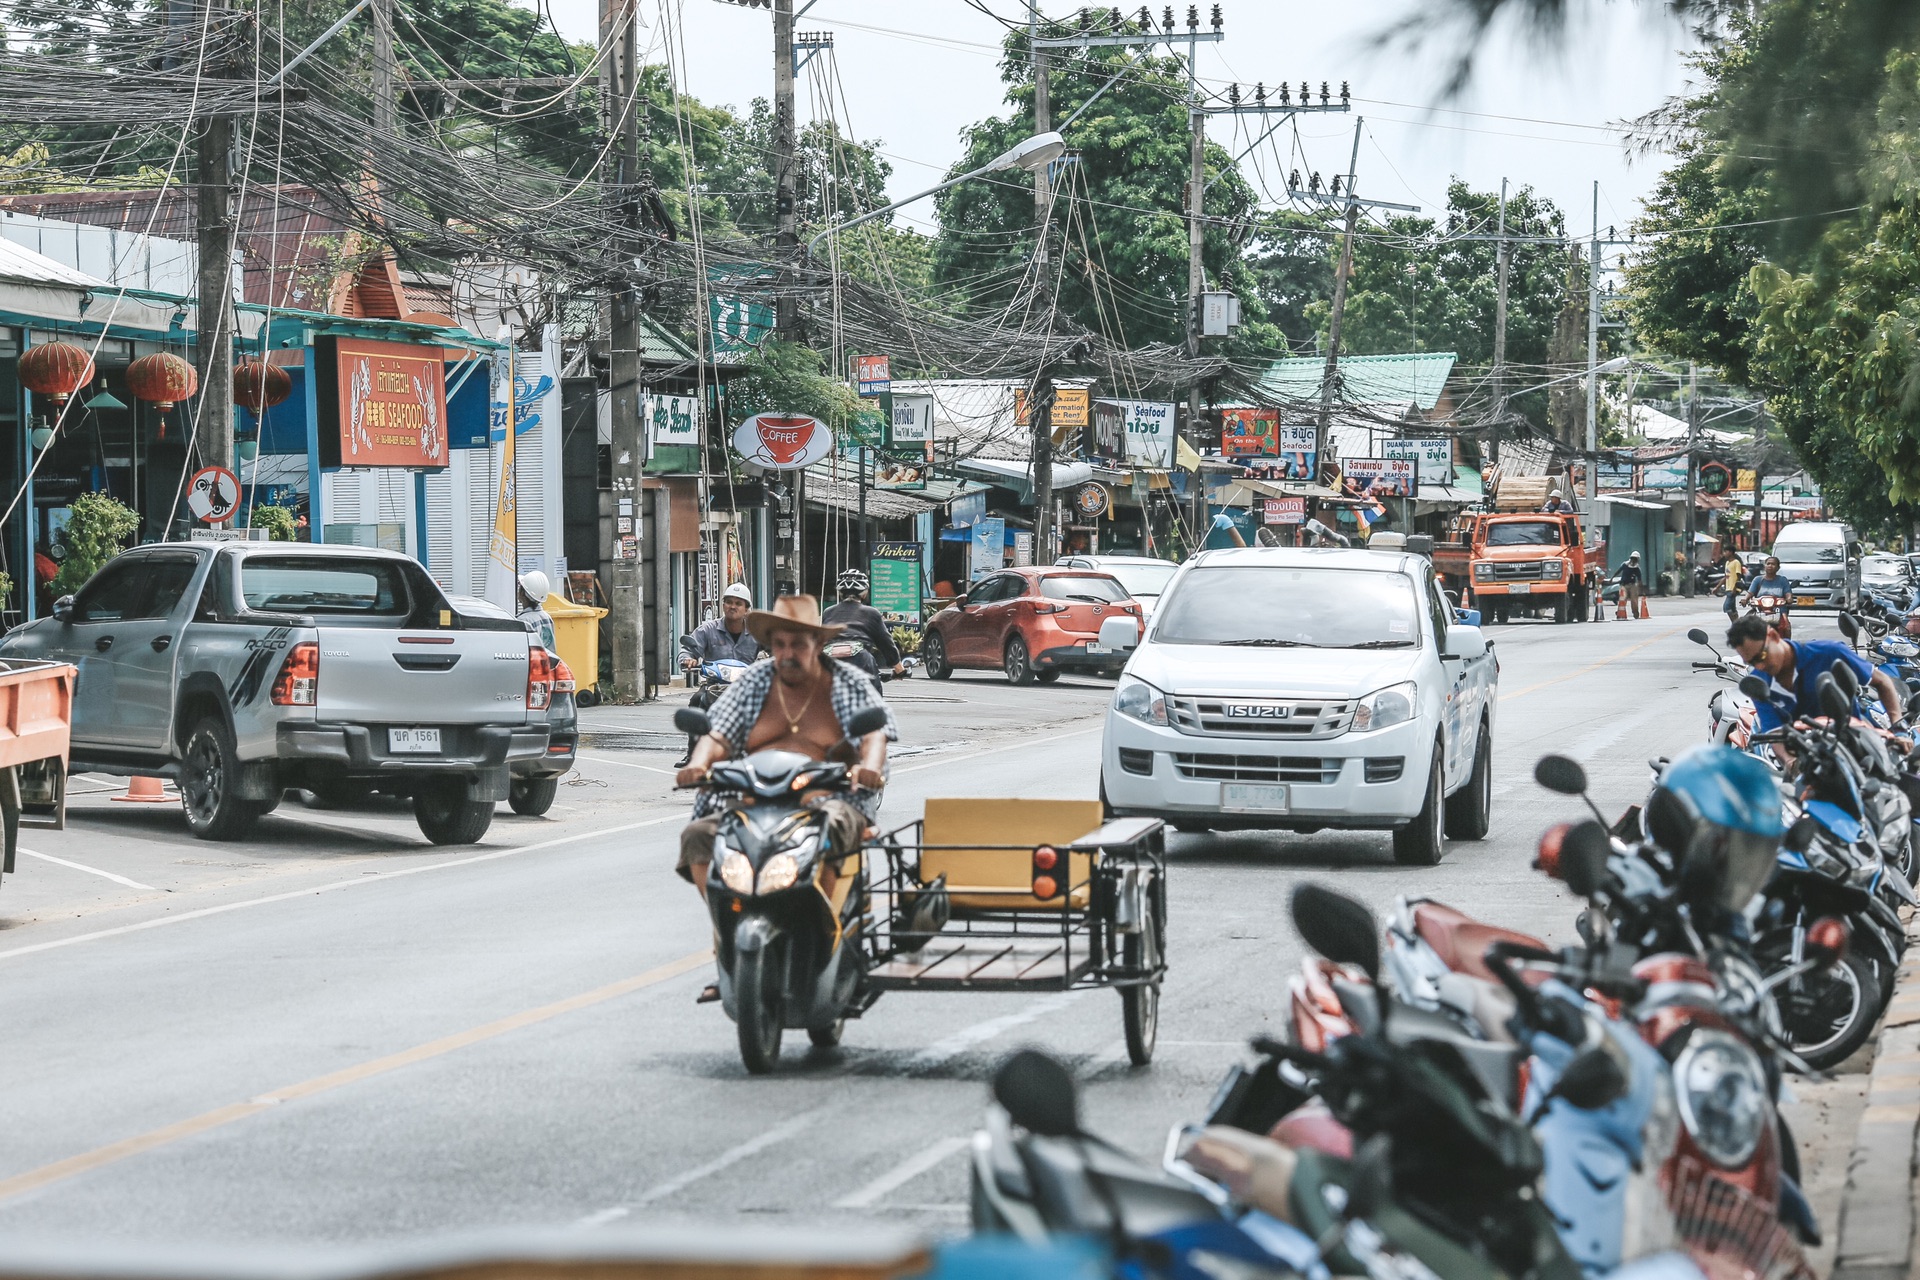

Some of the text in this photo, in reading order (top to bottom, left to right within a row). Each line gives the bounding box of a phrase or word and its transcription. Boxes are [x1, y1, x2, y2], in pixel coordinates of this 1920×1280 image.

[388, 401, 423, 430] SEAFOOD
[1135, 405, 1166, 418] Seafood
[1225, 419, 1276, 438] CANDY
[760, 427, 799, 444] COFFEE
[1282, 442, 1312, 450] Seafood
[1265, 500, 1303, 511] น้องปลา
[244, 639, 287, 651] ROCCO
[493, 652, 526, 661] HILUX
[1229, 705, 1287, 718] ISUZU
[414, 731, 438, 742] 1561
